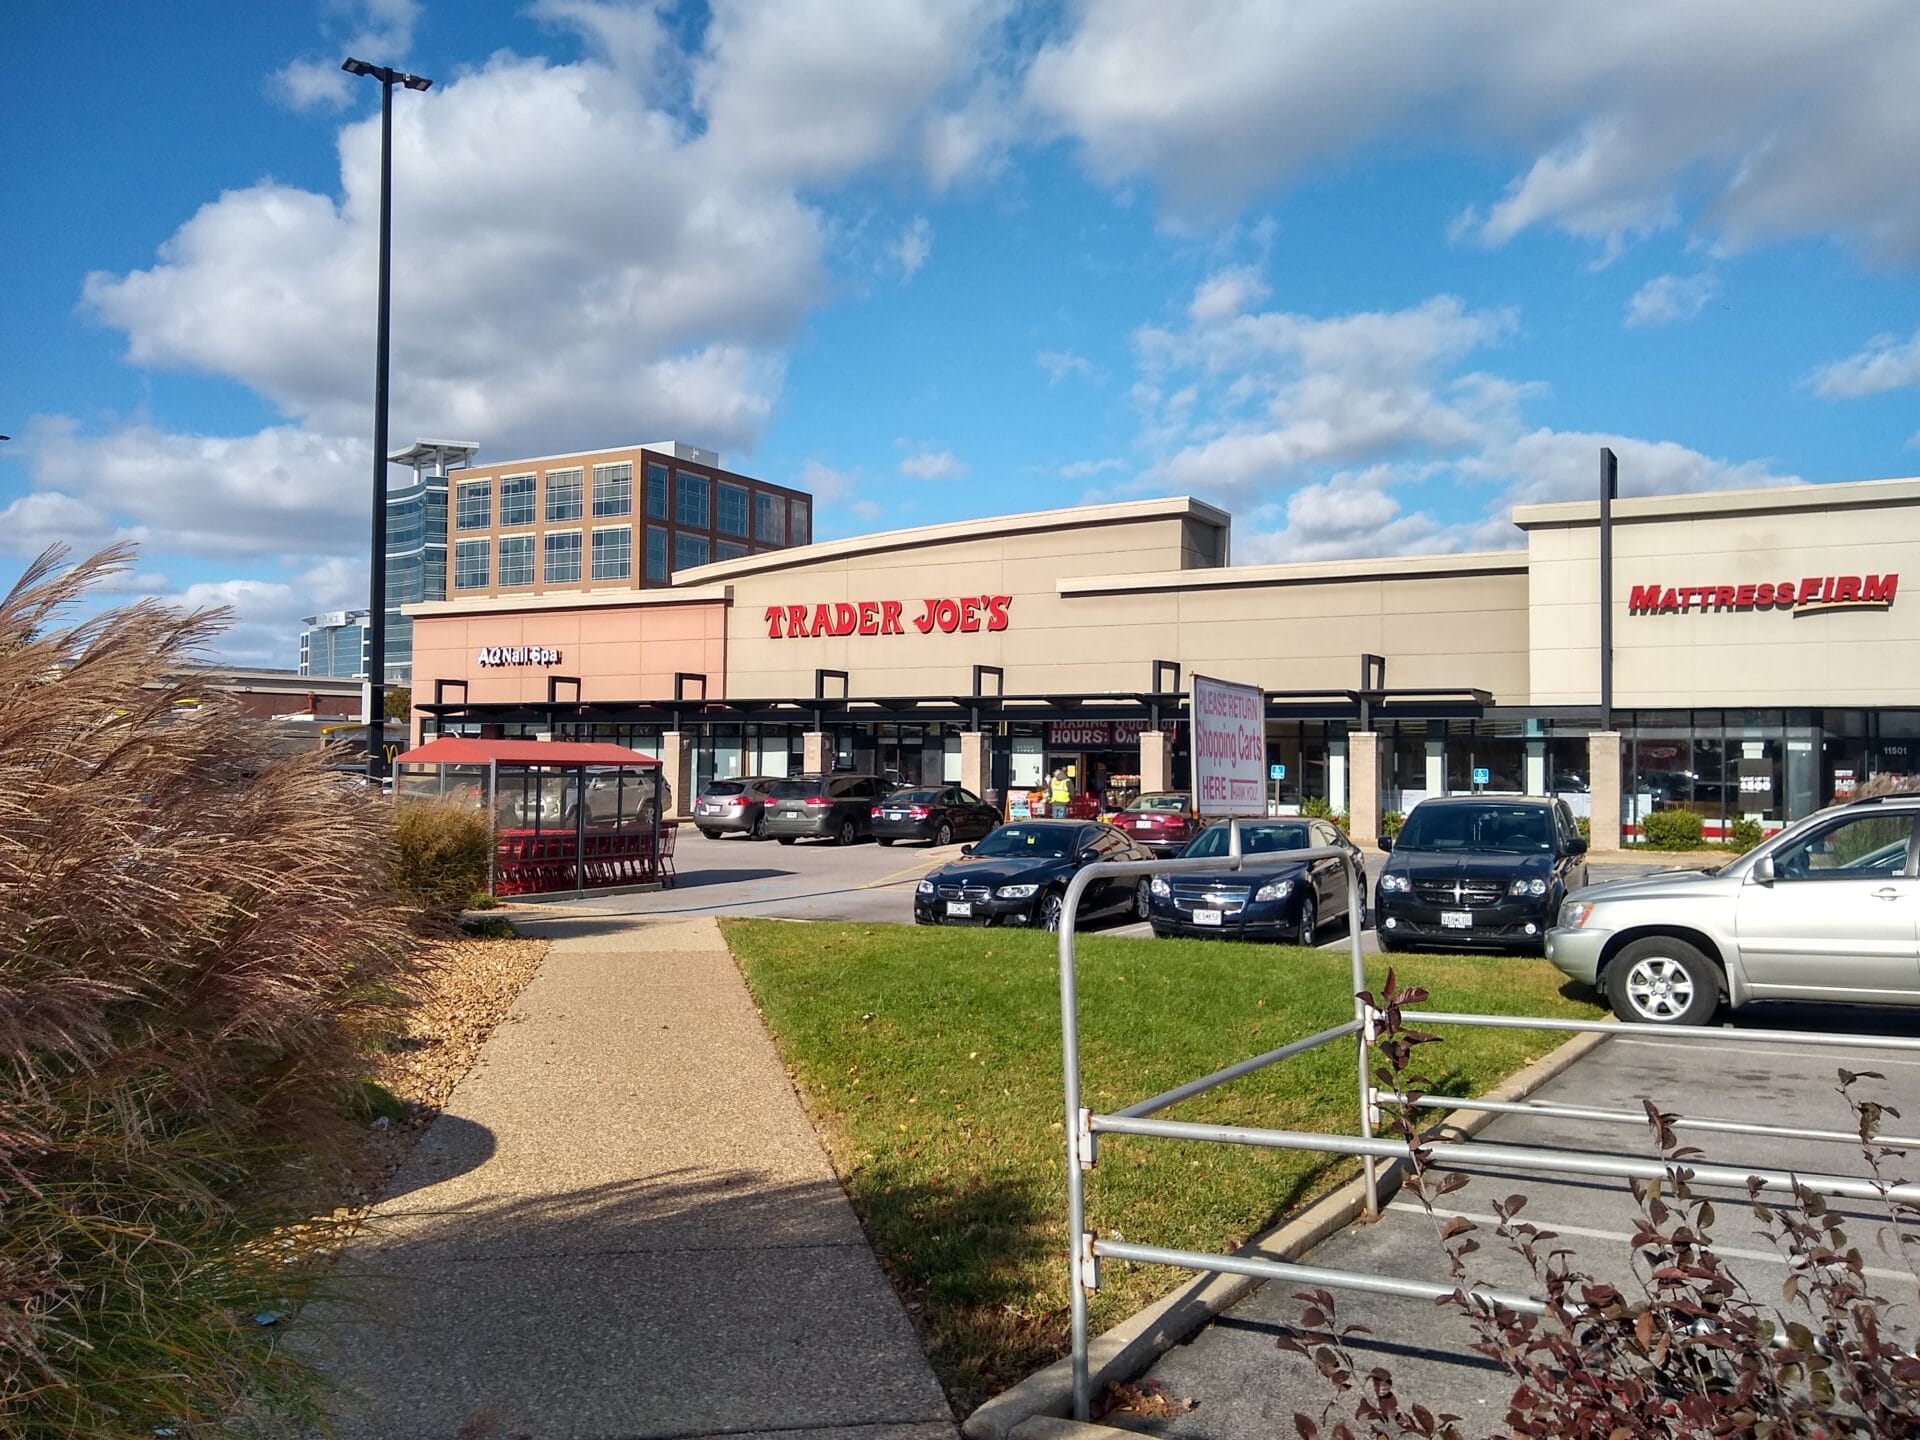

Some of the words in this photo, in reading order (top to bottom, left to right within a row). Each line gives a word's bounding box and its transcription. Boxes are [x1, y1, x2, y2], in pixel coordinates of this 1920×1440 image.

[765, 600, 905, 638] TRADER
[913, 595, 1012, 634] JOE'S
[478, 647, 502, 665] AQ
[502, 647, 528, 663] Nail
[531, 647, 560, 666] Spa
[1199, 688, 1227, 717] PLEASE
[1229, 695, 1258, 720] RETURN
[1051, 730, 1108, 743] HOURS:
[1197, 719, 1237, 768] Shopping
[1238, 724, 1262, 762] Carts
[1883, 746, 1908, 755] 11501
[1202, 775, 1226, 800] HERE
